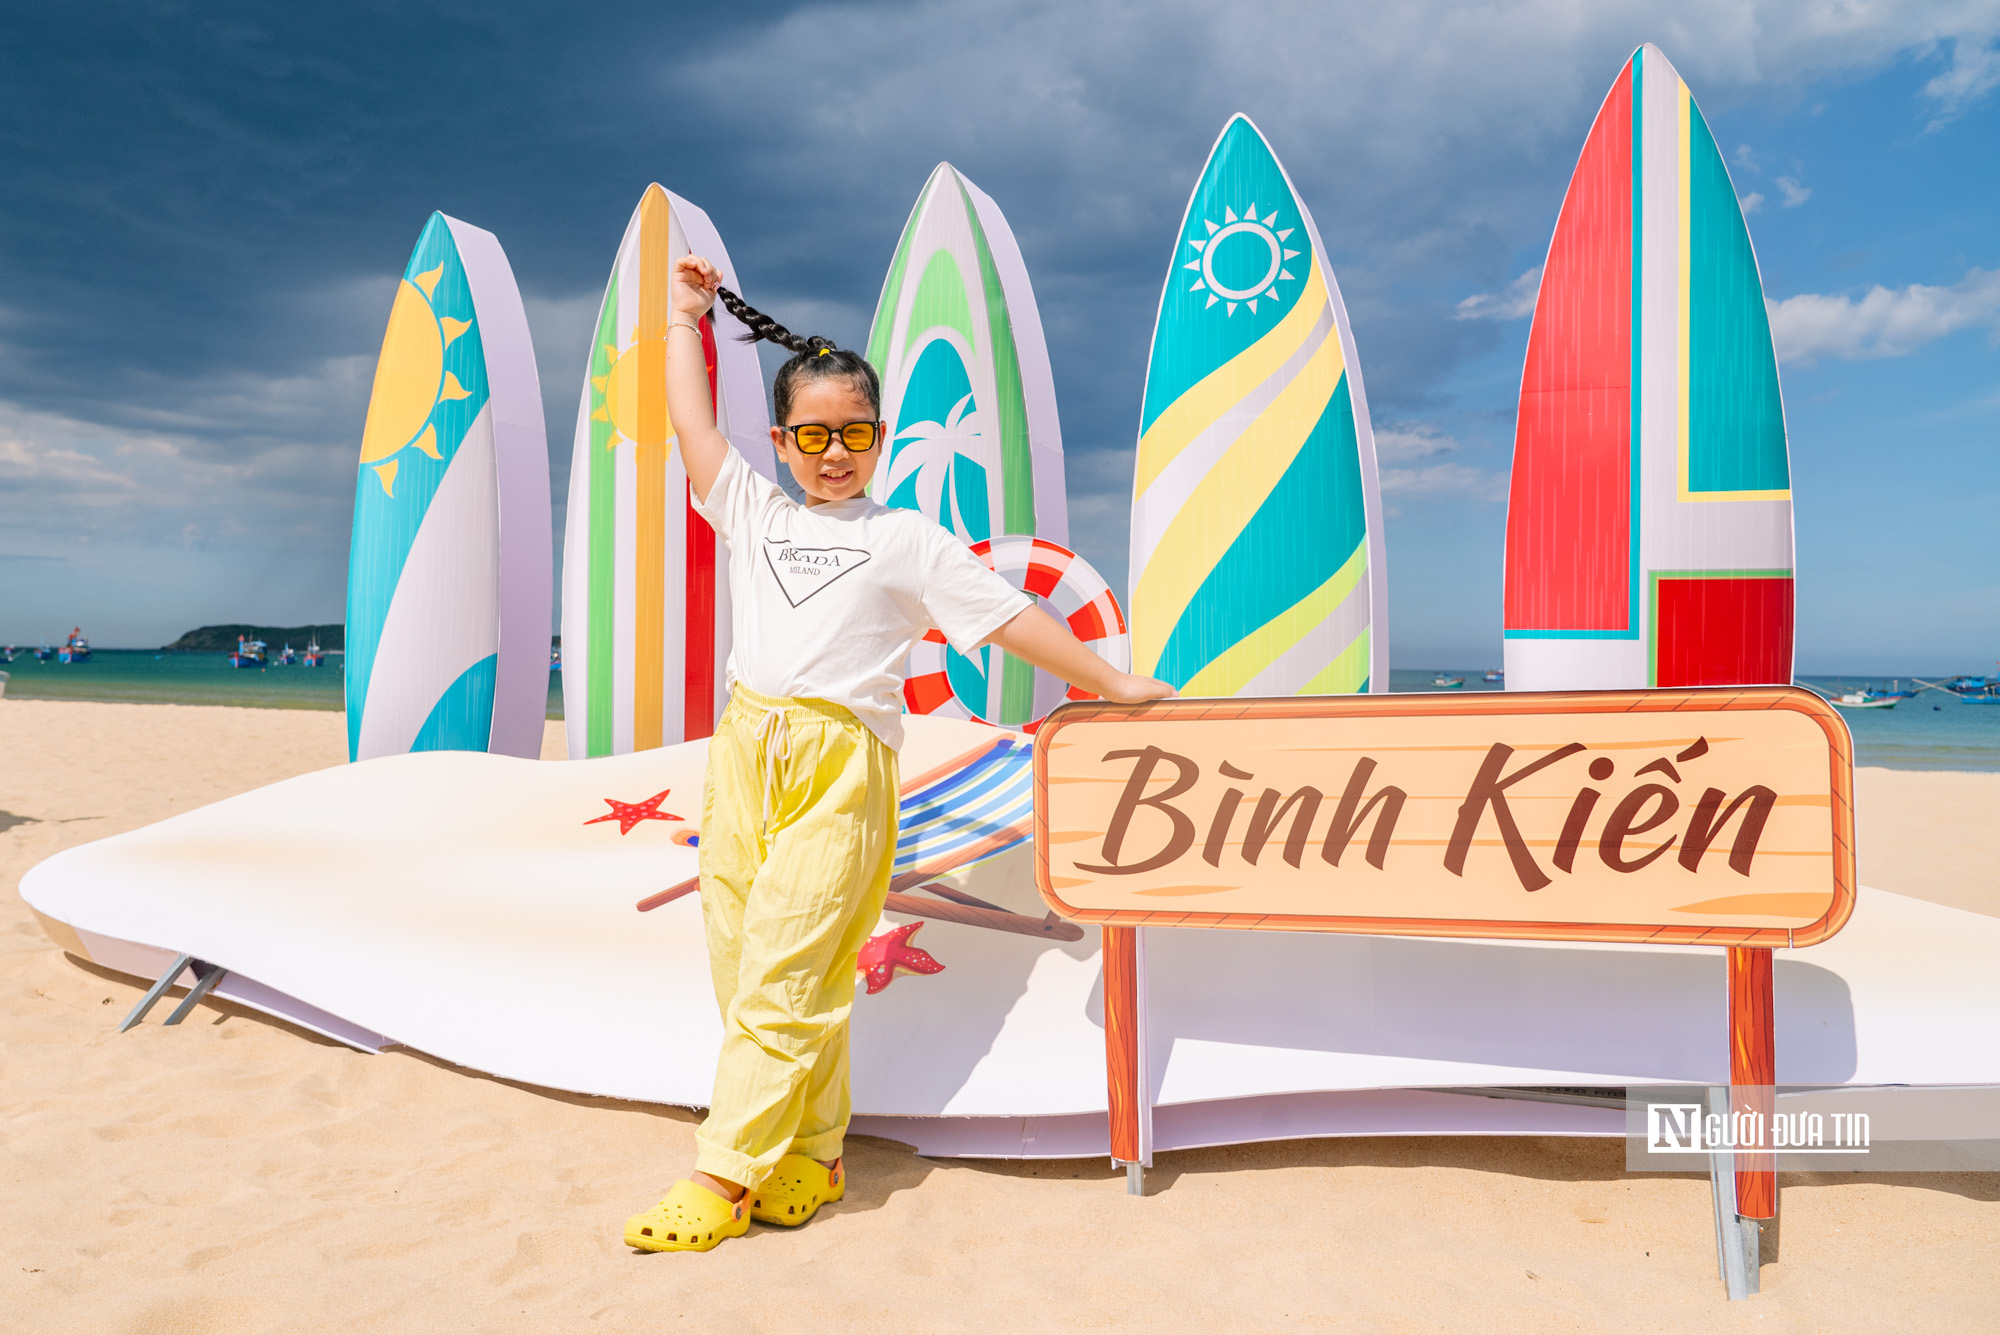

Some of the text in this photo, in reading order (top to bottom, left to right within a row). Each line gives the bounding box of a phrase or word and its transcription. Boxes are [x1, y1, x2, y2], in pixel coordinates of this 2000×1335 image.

[777, 547, 841, 567] BRADA
[1072, 735, 1779, 893] Bình Kiến
